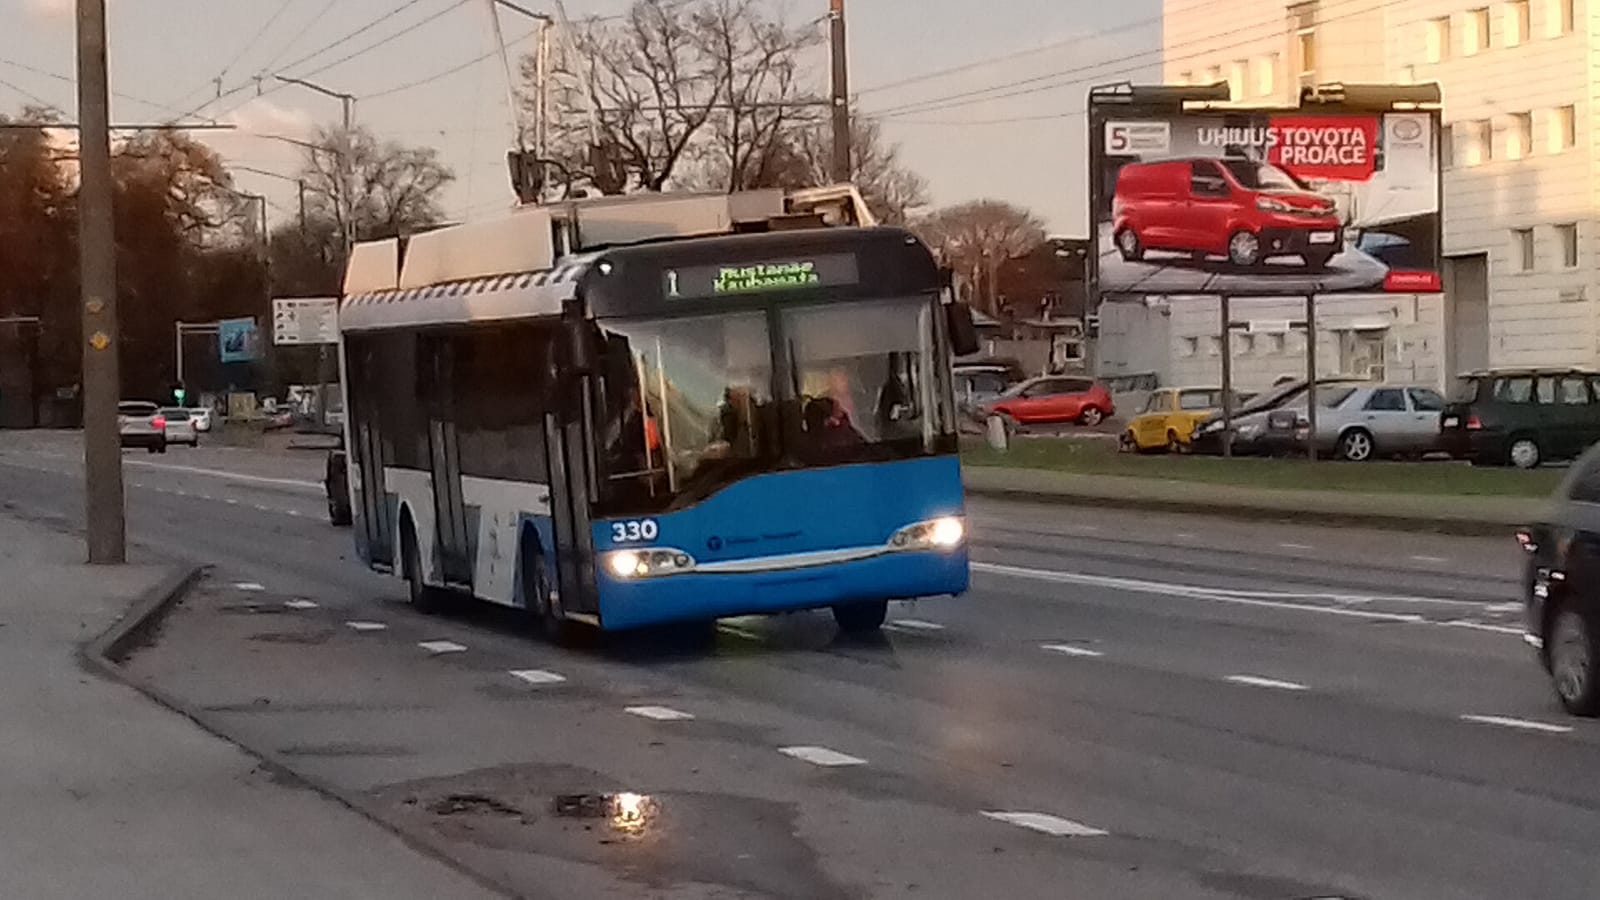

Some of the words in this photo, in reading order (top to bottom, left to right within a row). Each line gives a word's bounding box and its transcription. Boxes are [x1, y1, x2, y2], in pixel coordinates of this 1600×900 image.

[1111, 127, 1128, 151] 5
[1280, 127, 1367, 146] TOYOTA
[1280, 146, 1367, 165] PROACE
[612, 519, 658, 542] 330
